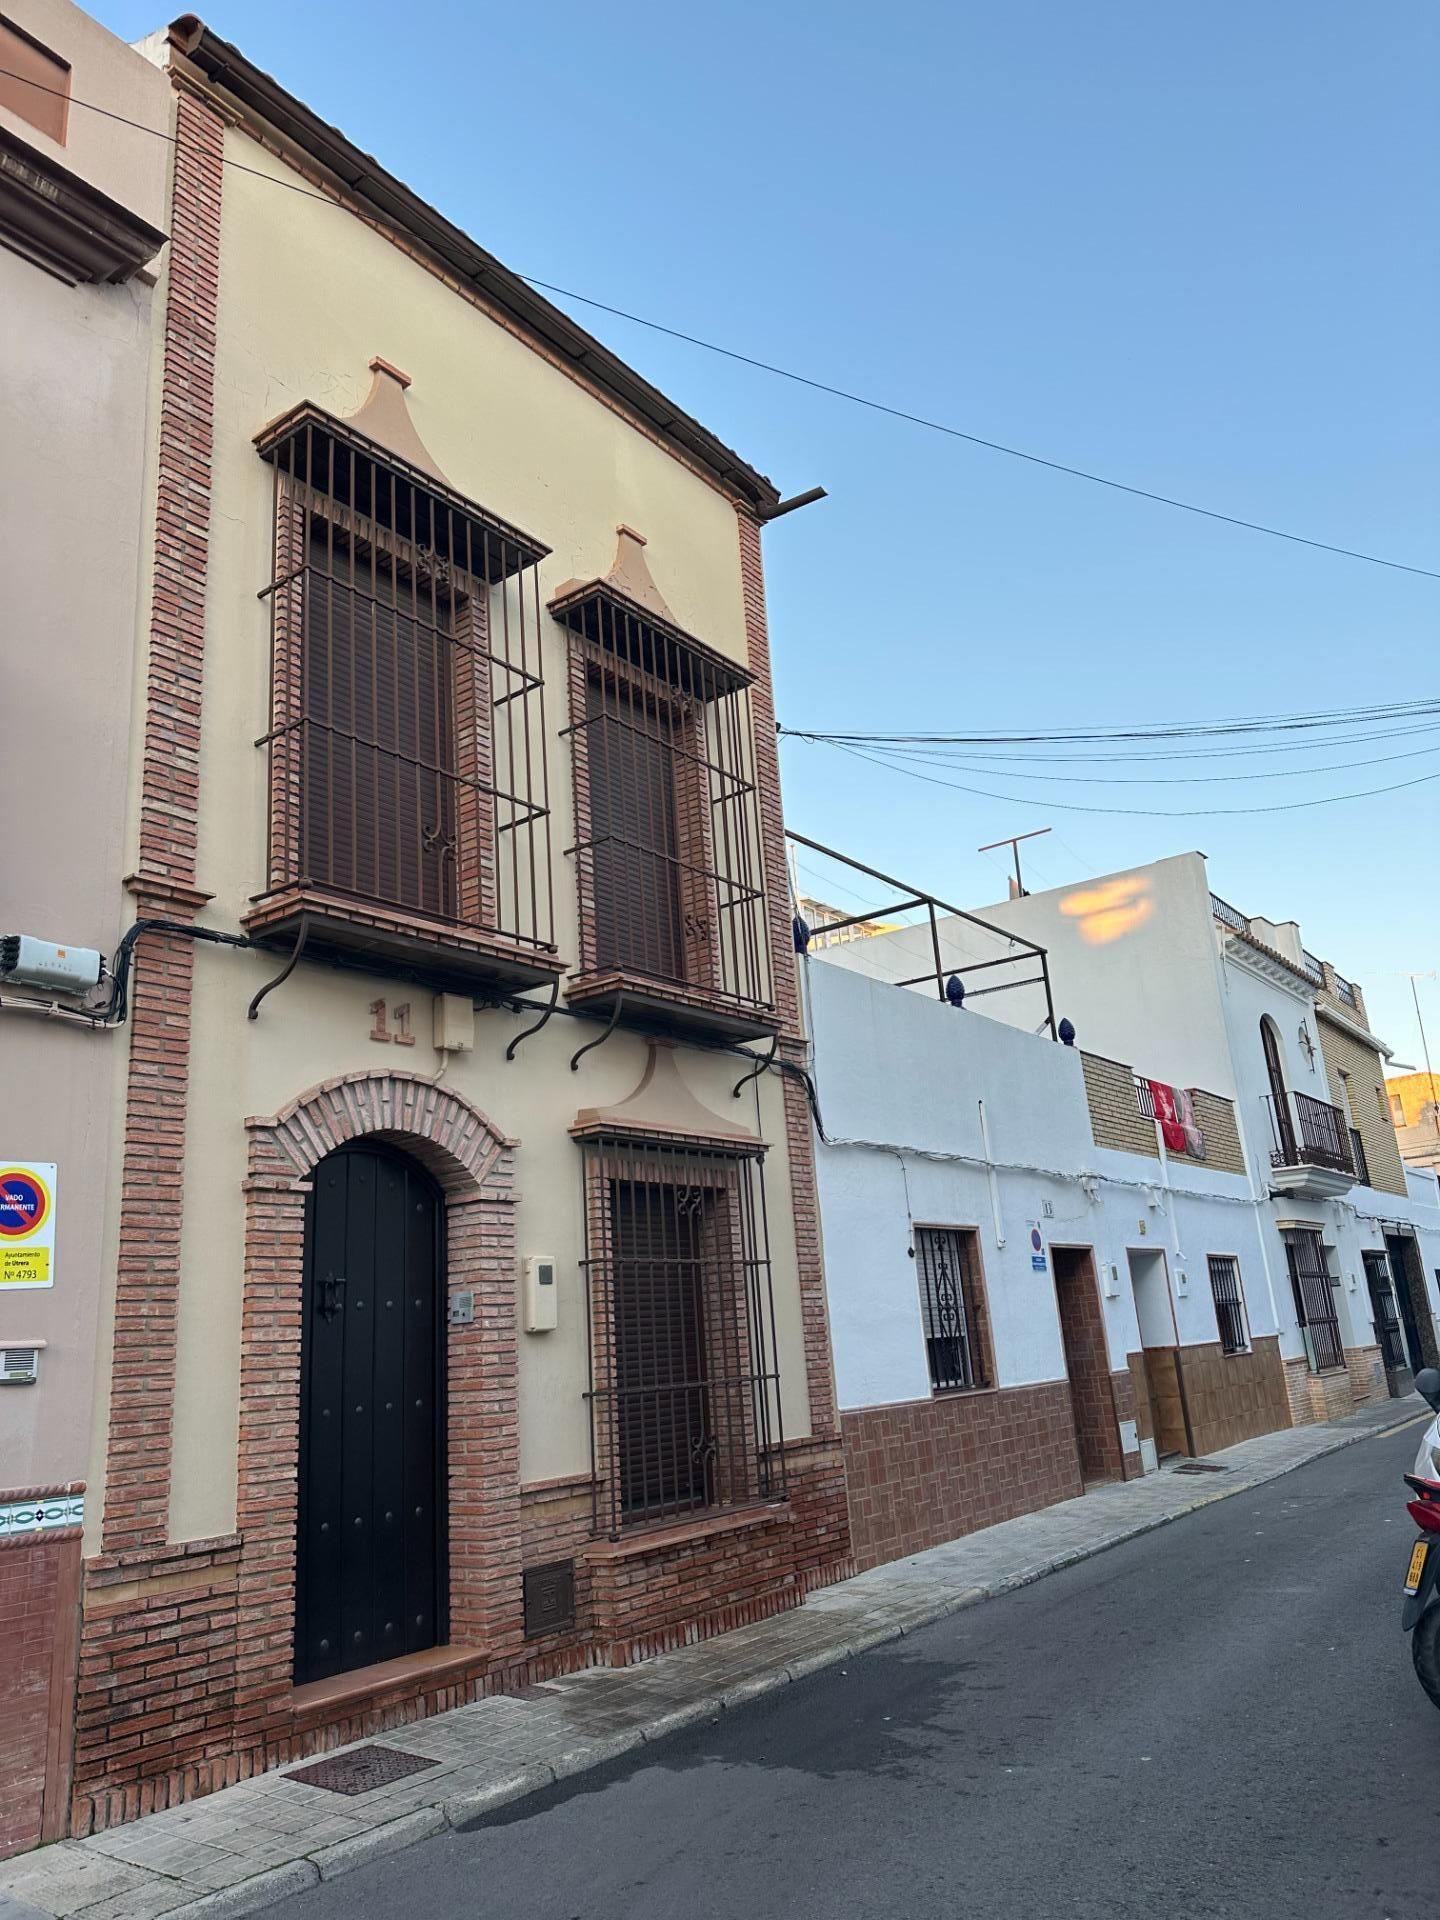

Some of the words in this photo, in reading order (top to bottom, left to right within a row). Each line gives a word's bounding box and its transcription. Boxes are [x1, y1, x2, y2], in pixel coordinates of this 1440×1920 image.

[369, 998, 416, 1047] 11
[0, 1203, 35, 1211] RMANENTE
[16, 1269, 37, 1279] 4793
